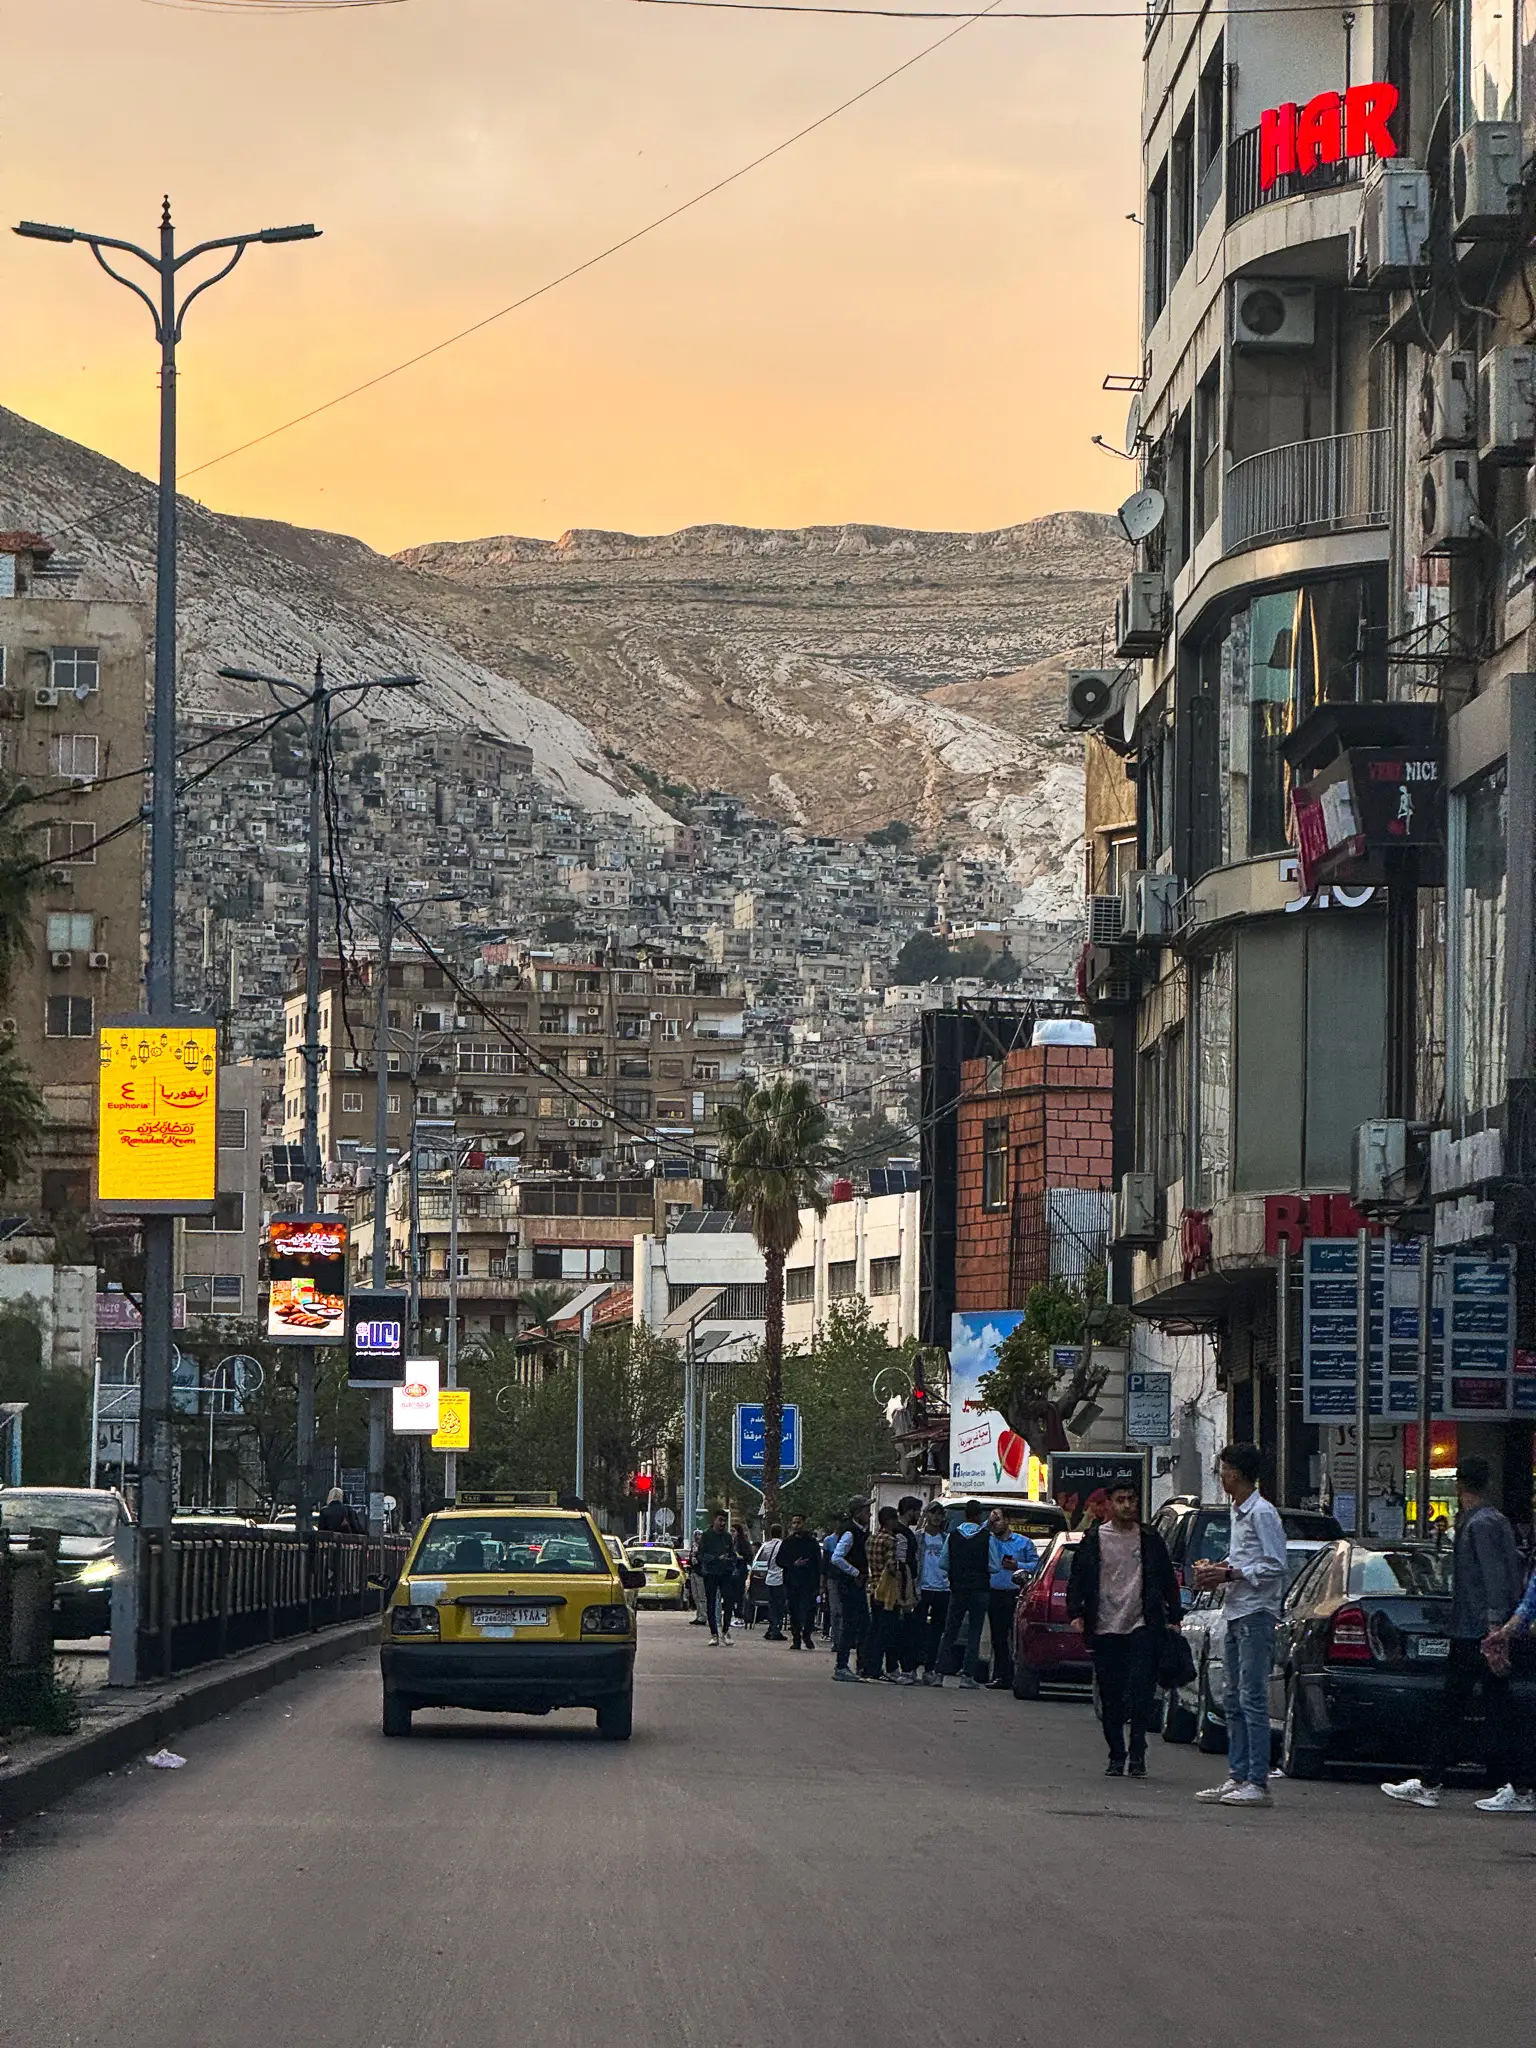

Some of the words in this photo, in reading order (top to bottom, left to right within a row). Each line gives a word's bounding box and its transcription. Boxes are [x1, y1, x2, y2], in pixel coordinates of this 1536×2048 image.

[1261, 82, 1398, 191] HAR
[1405, 761, 1438, 781] NICE
[107, 1102, 149, 1111] Euphoria
[1131, 1375, 1143, 1390] P
[1060, 1465, 1095, 1479] الاختيار
[1096, 1466, 1113, 1477] قبل
